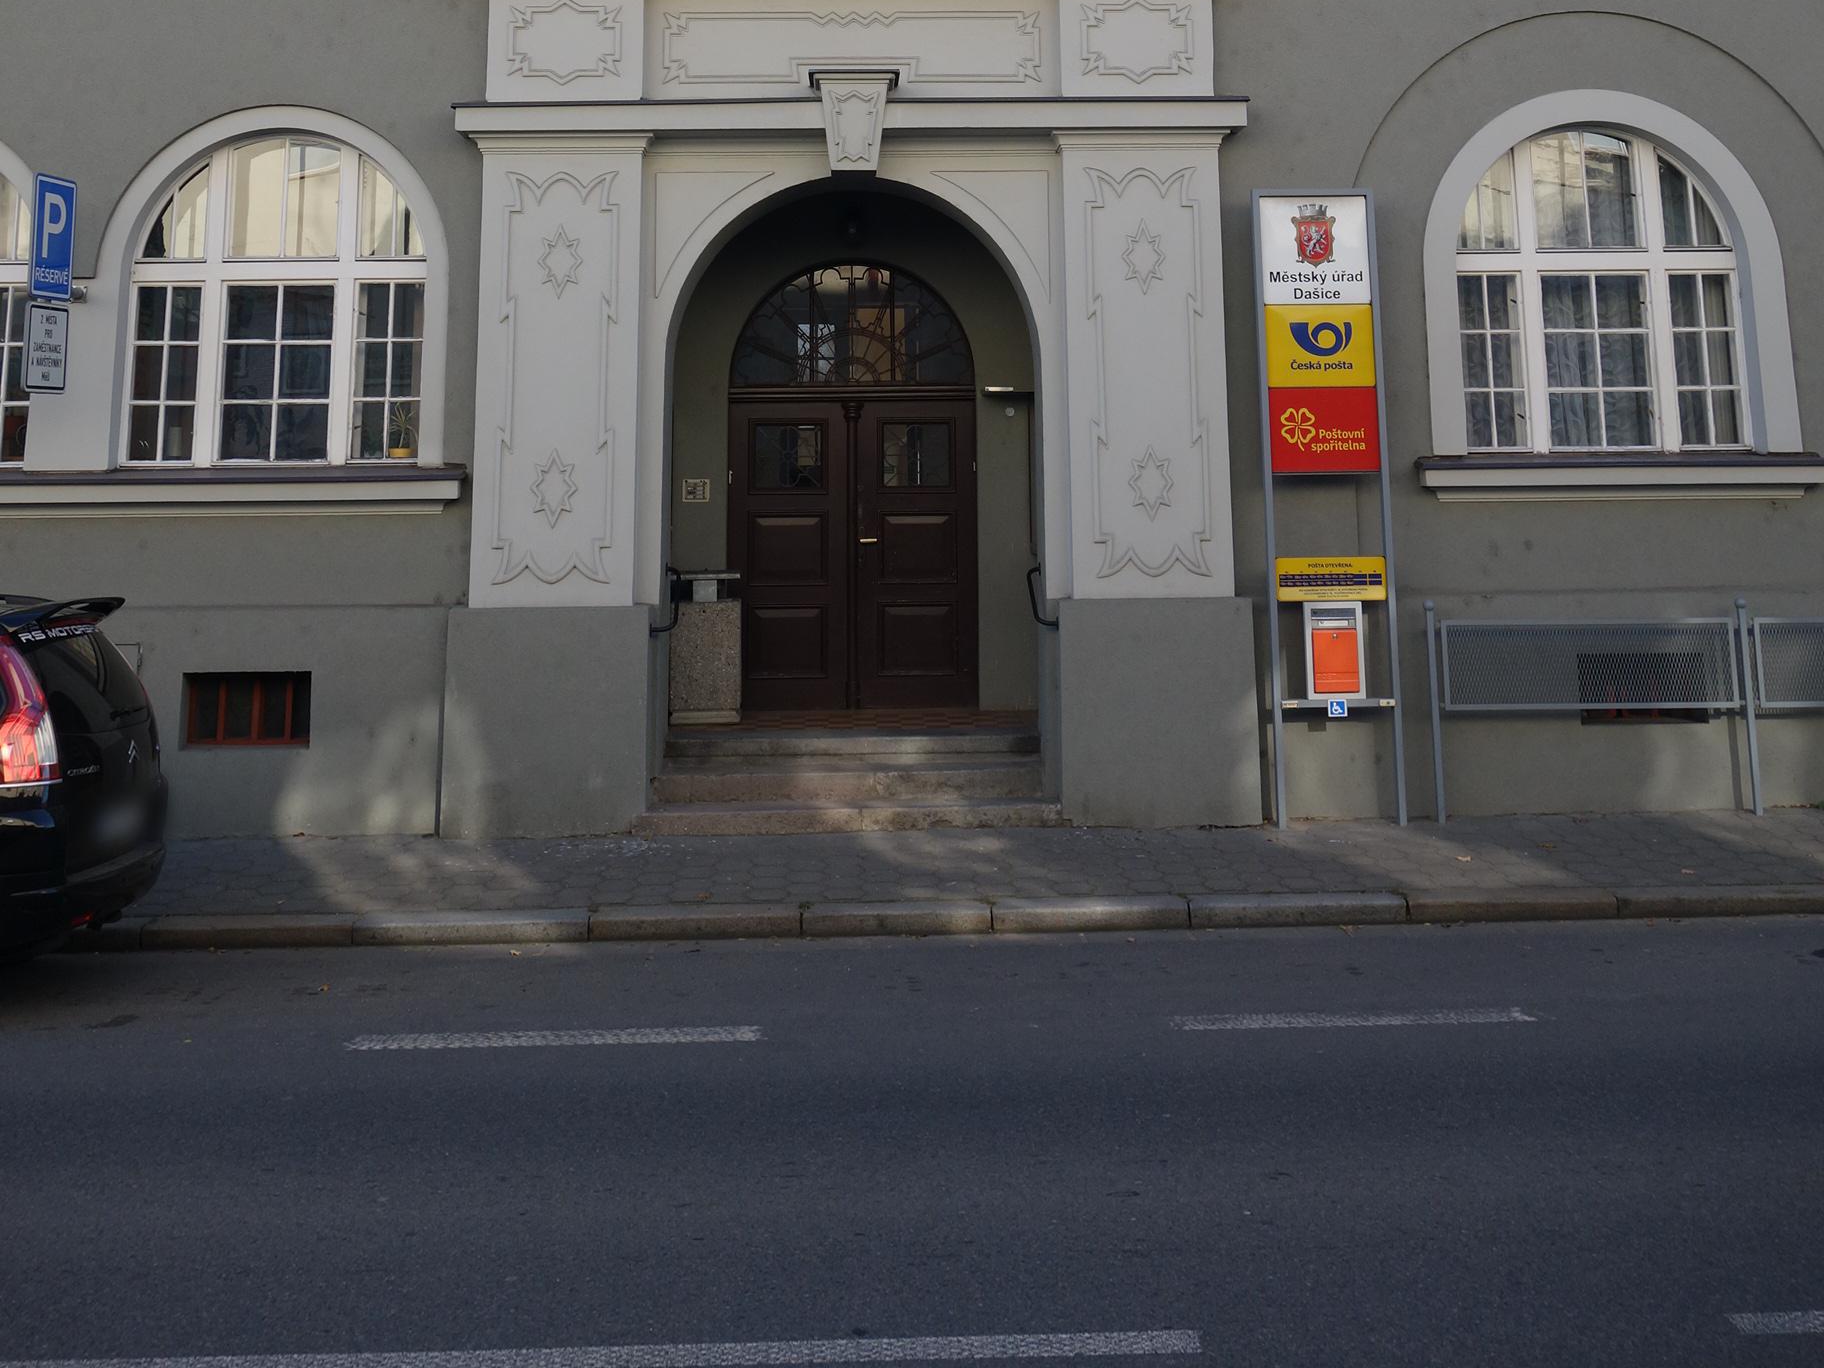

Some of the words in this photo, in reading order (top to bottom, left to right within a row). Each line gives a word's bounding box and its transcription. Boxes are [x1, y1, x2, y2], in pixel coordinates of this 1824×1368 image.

[41, 191, 67, 259] P
[1269, 271, 1327, 285] Městský
[1332, 270, 1363, 282] úřad
[1293, 287, 1341, 300] Dašice
[44, 328, 53, 339] PRO
[1290, 359, 1322, 370] Česká
[1324, 360, 1353, 372] pošta
[1319, 428, 1365, 440] Poštovní
[1311, 439, 1366, 453] spořitelna
[18, 630, 46, 643] RS
